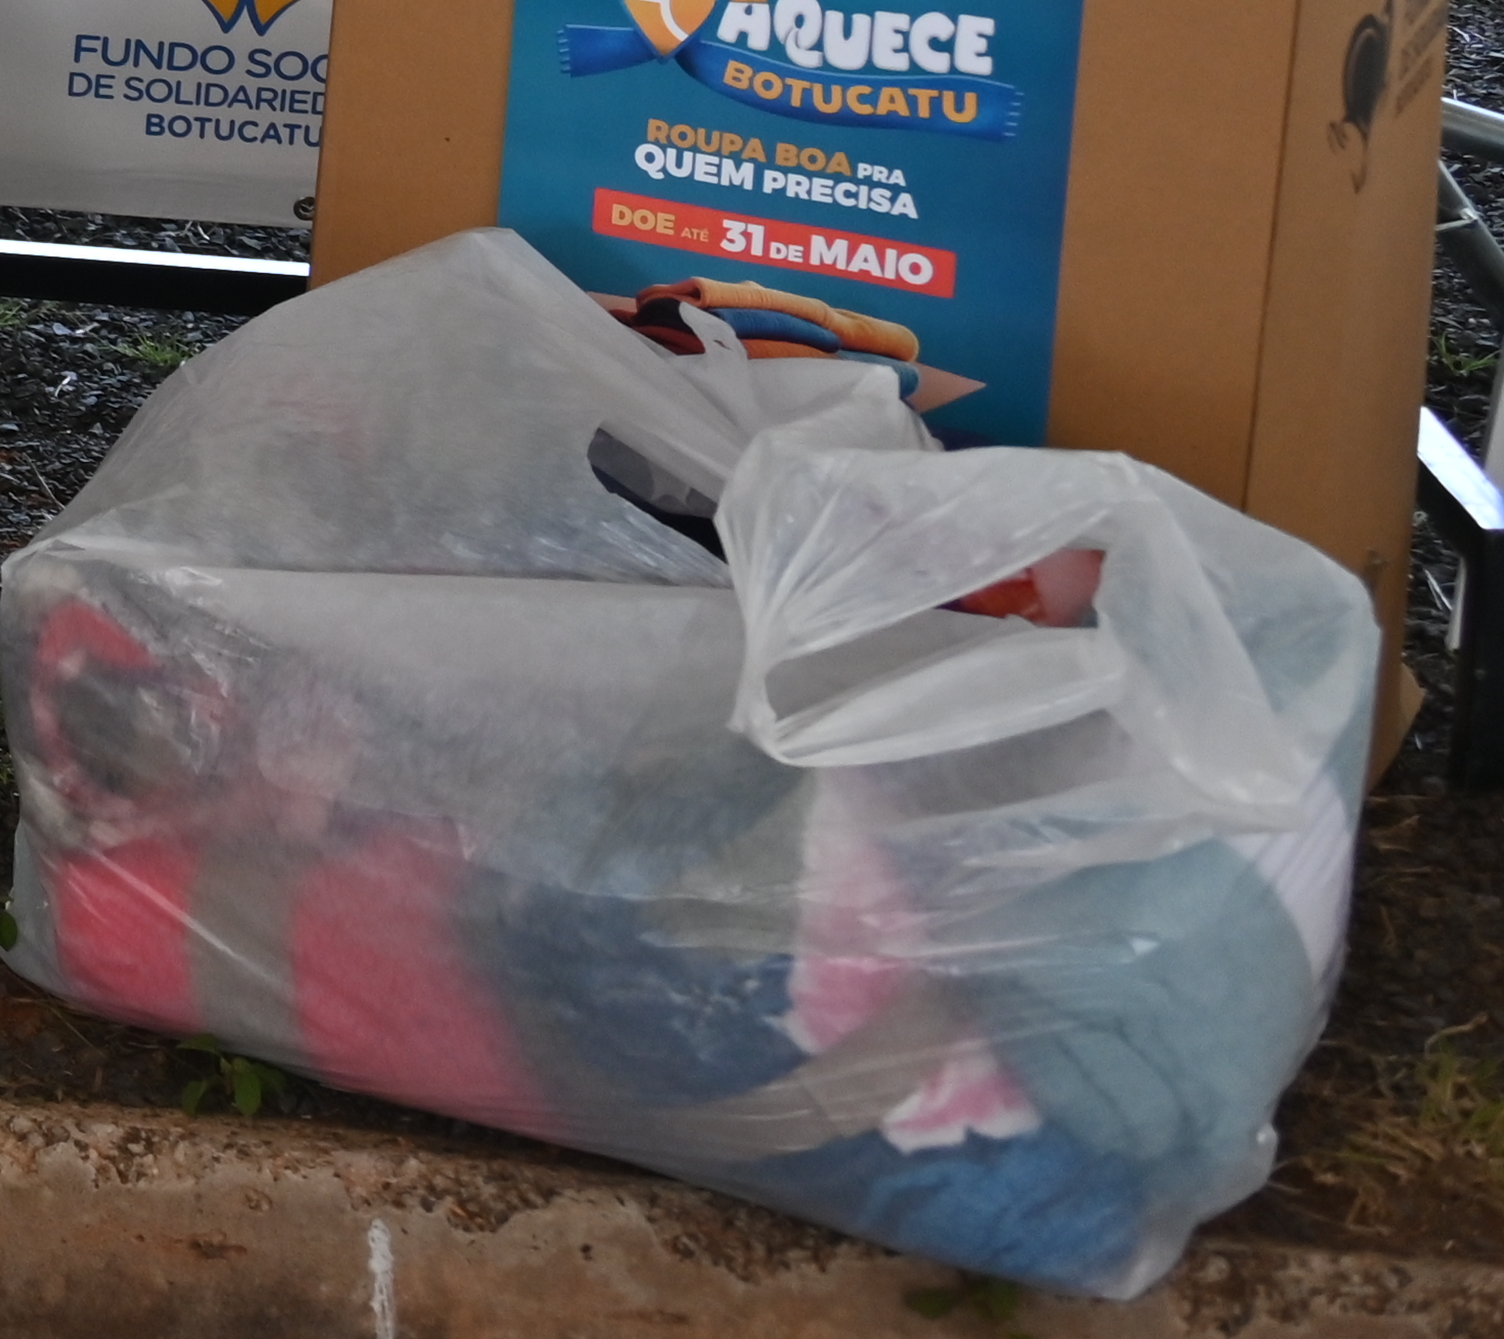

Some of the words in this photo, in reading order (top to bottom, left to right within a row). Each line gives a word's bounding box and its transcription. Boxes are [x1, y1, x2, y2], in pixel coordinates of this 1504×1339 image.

[67, 71, 117, 100] DE
[73, 33, 236, 75] FUNDO
[245, 47, 329, 86] SOC
[722, 59, 978, 124] BOTUCATU
[145, 112, 323, 148] BOTUCATU
[646, 118, 768, 164] ROUPA
[774, 141, 854, 177] BOA
[856, 162, 907, 187] PRA
[634, 142, 756, 191] QUEM
[762, 168, 920, 220] PRECISA
[610, 203, 677, 237] DOE
[680, 225, 710, 243] ATÉ
[719, 218, 766, 257] 31
[769, 240, 805, 264] DE
[809, 234, 935, 286] MAIO
